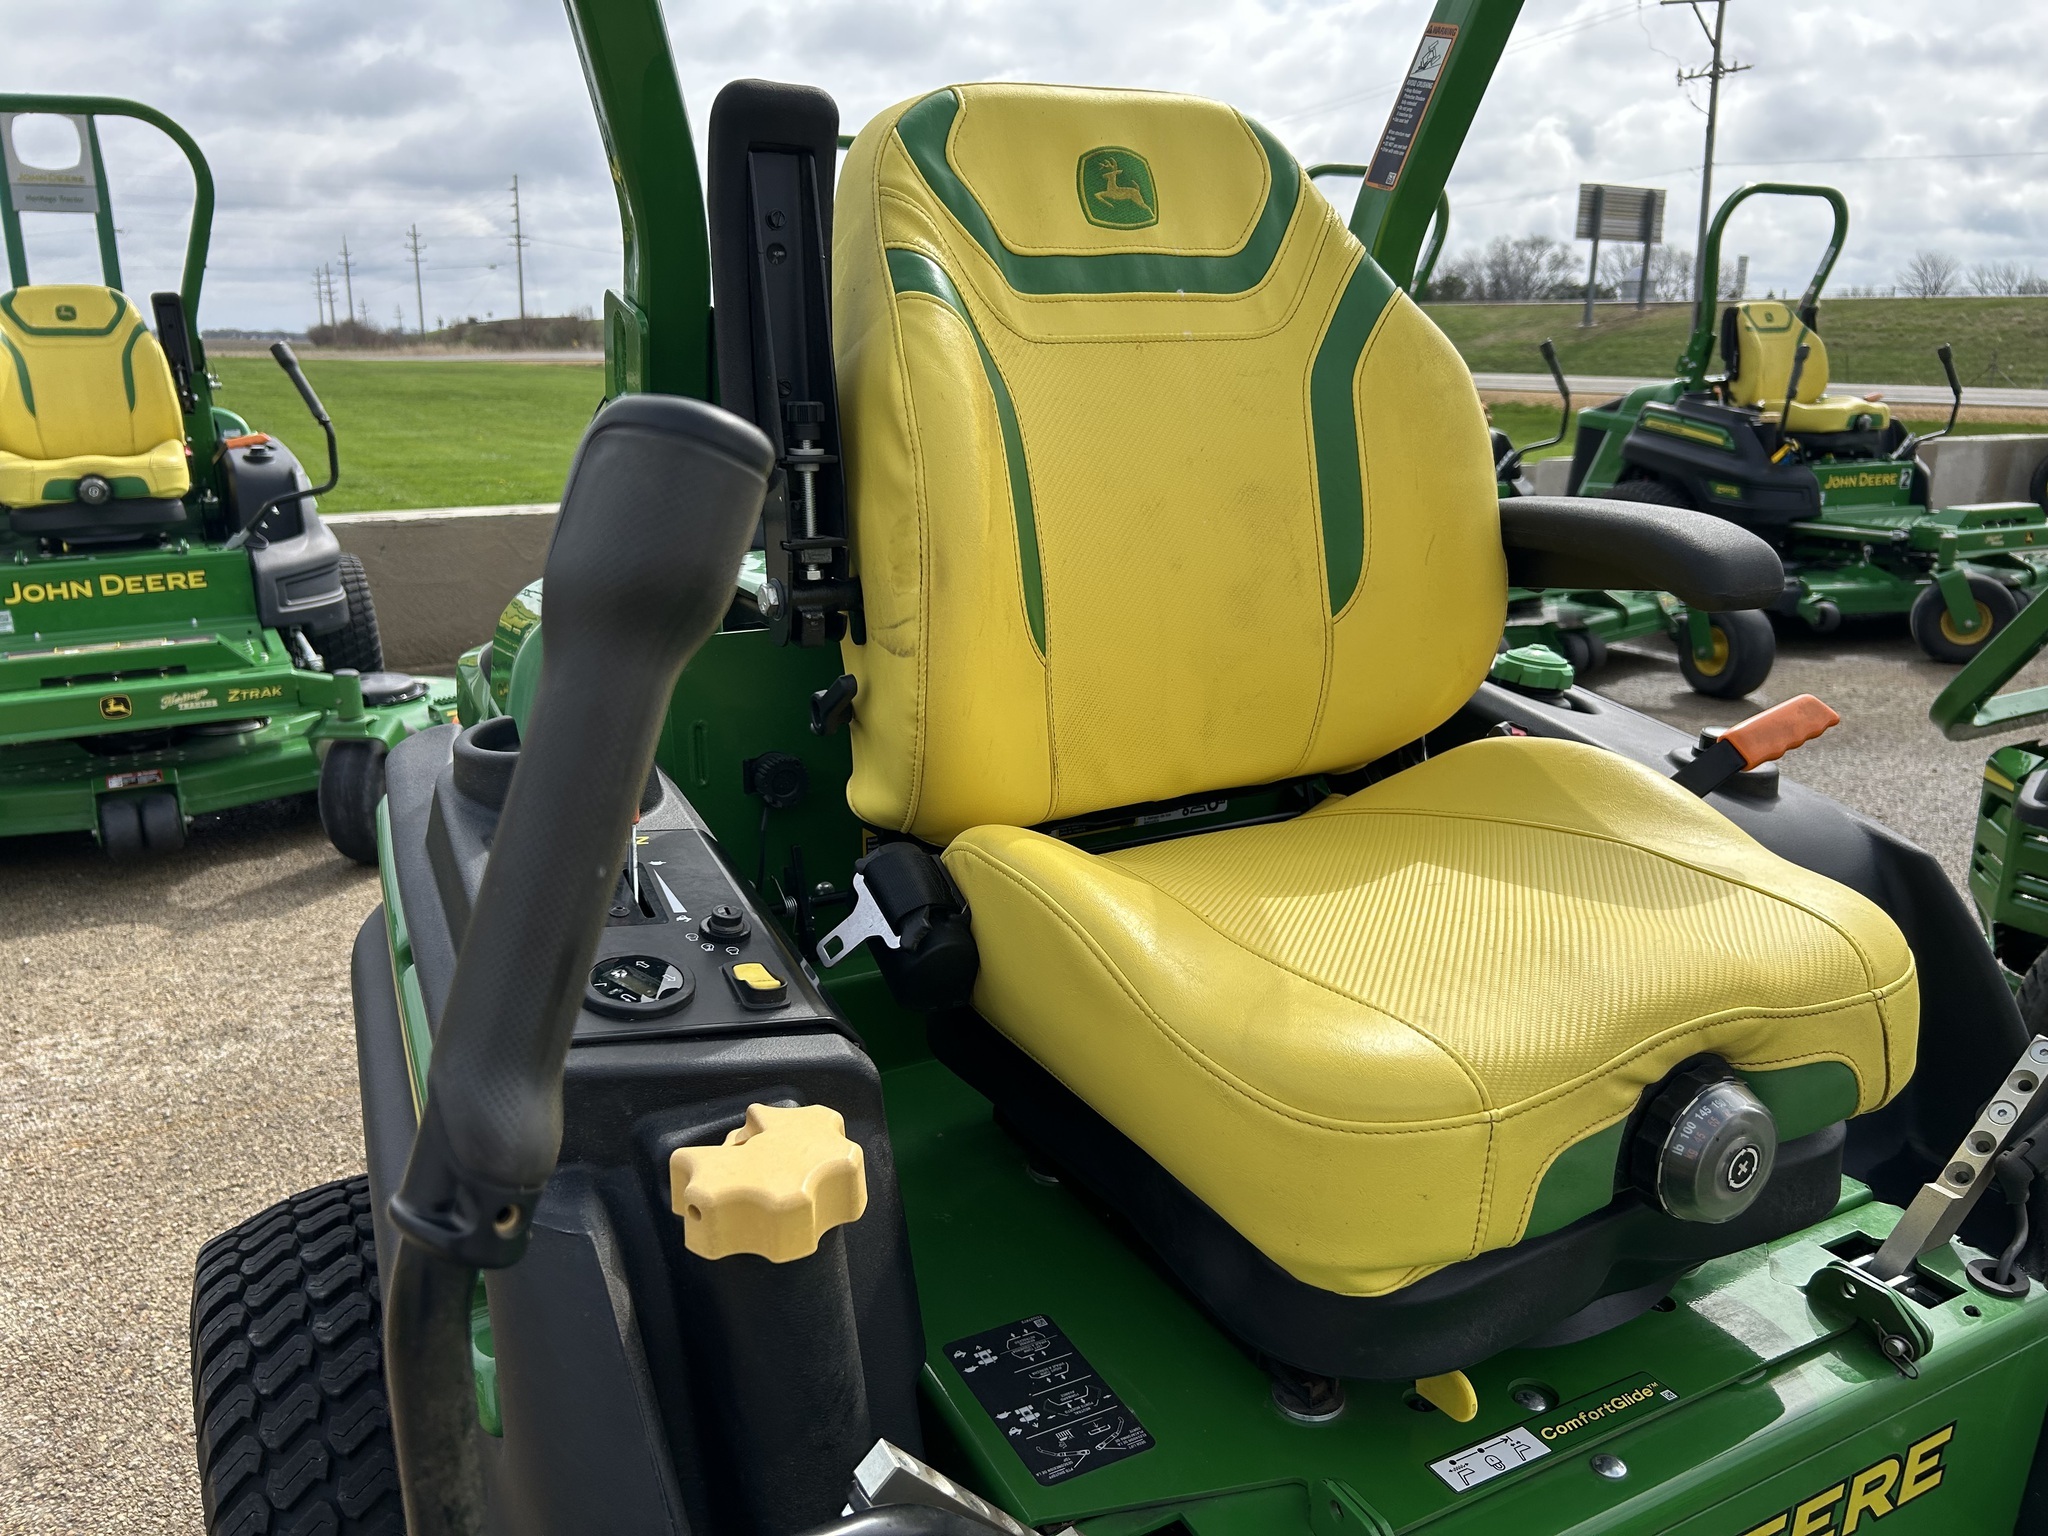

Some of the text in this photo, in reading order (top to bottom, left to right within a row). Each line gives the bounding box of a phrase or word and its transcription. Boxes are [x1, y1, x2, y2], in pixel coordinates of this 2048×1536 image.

[1824, 472, 1898, 489] JOHN DEERE
[1901, 471, 1910, 488] 2
[4, 569, 208, 605] JOHN DEERE
[227, 685, 282, 702] ZTRAK
[1672, 1143, 1685, 1156] lb
[1680, 1121, 1697, 1139] 100
[1695, 1105, 1712, 1120] 145
[1684, 1148, 1699, 1160] kg
[1740, 1425, 1954, 1536] ERE
